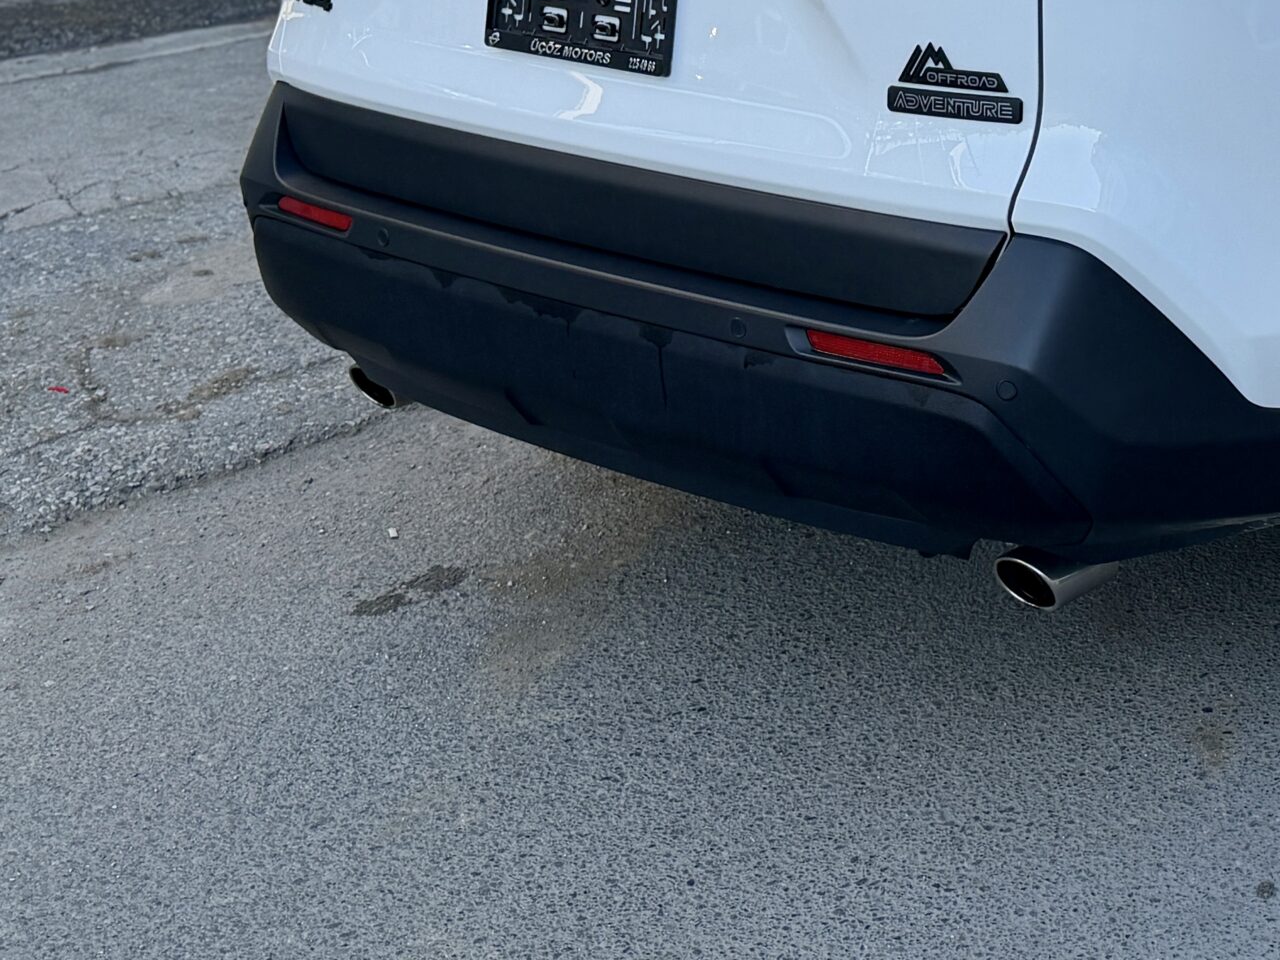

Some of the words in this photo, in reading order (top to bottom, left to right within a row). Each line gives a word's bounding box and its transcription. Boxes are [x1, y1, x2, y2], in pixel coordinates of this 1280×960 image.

[530, 38, 562, 56] ÜÇÖZ
[562, 46, 612, 65] MOTORS
[893, 90, 1013, 120] ADVENTURE
